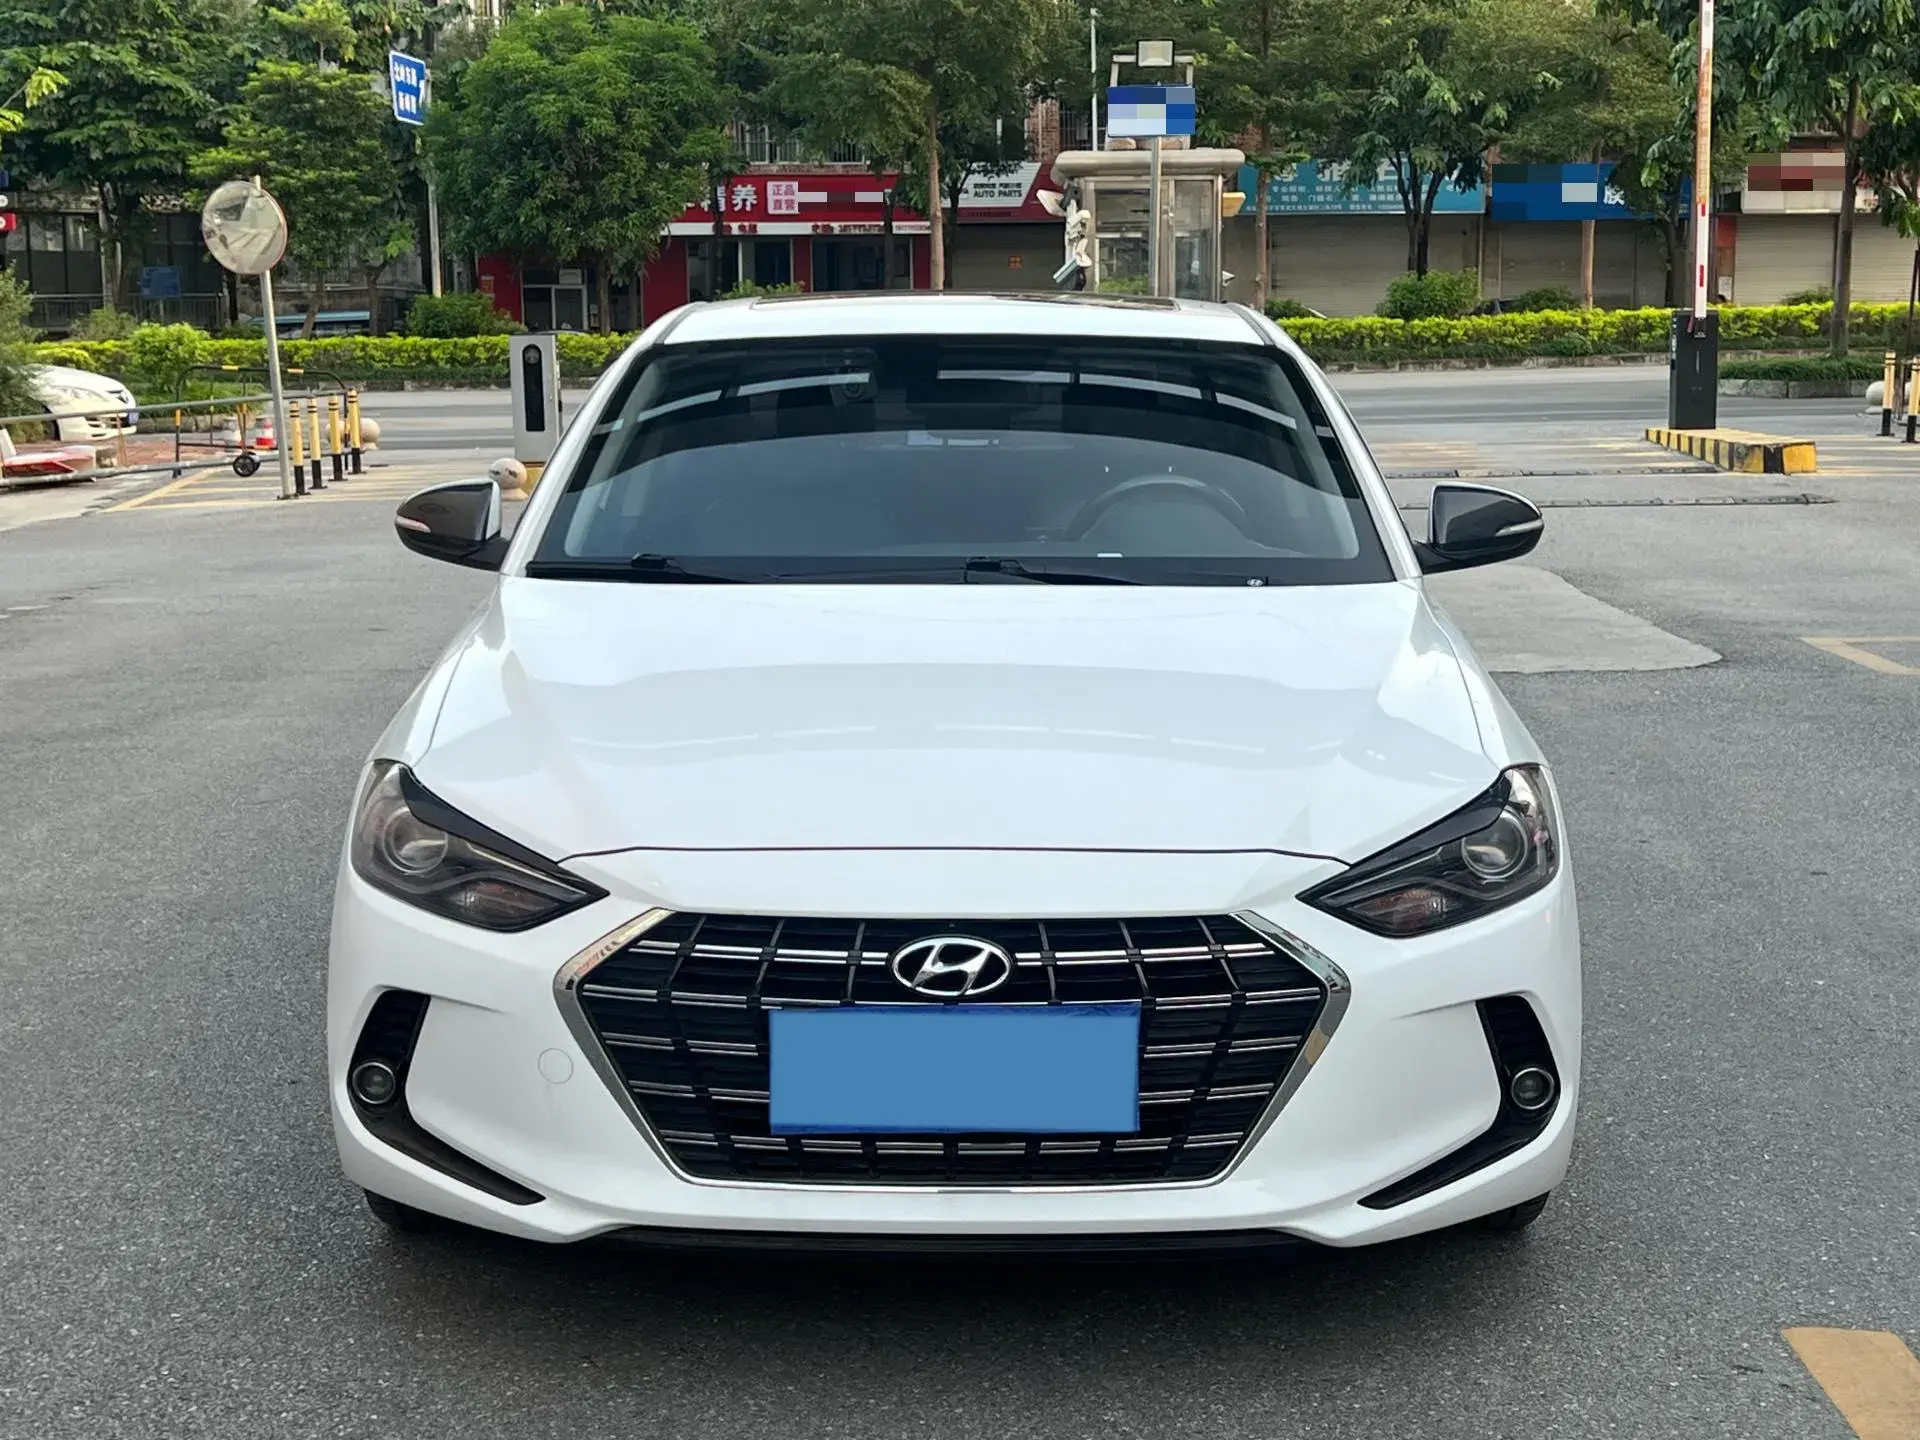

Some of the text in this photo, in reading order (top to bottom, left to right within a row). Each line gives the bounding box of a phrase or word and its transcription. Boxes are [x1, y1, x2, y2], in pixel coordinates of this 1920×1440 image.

[772, 184, 795, 196] 正品
[973, 190, 1023, 198] AUTO PARTS
